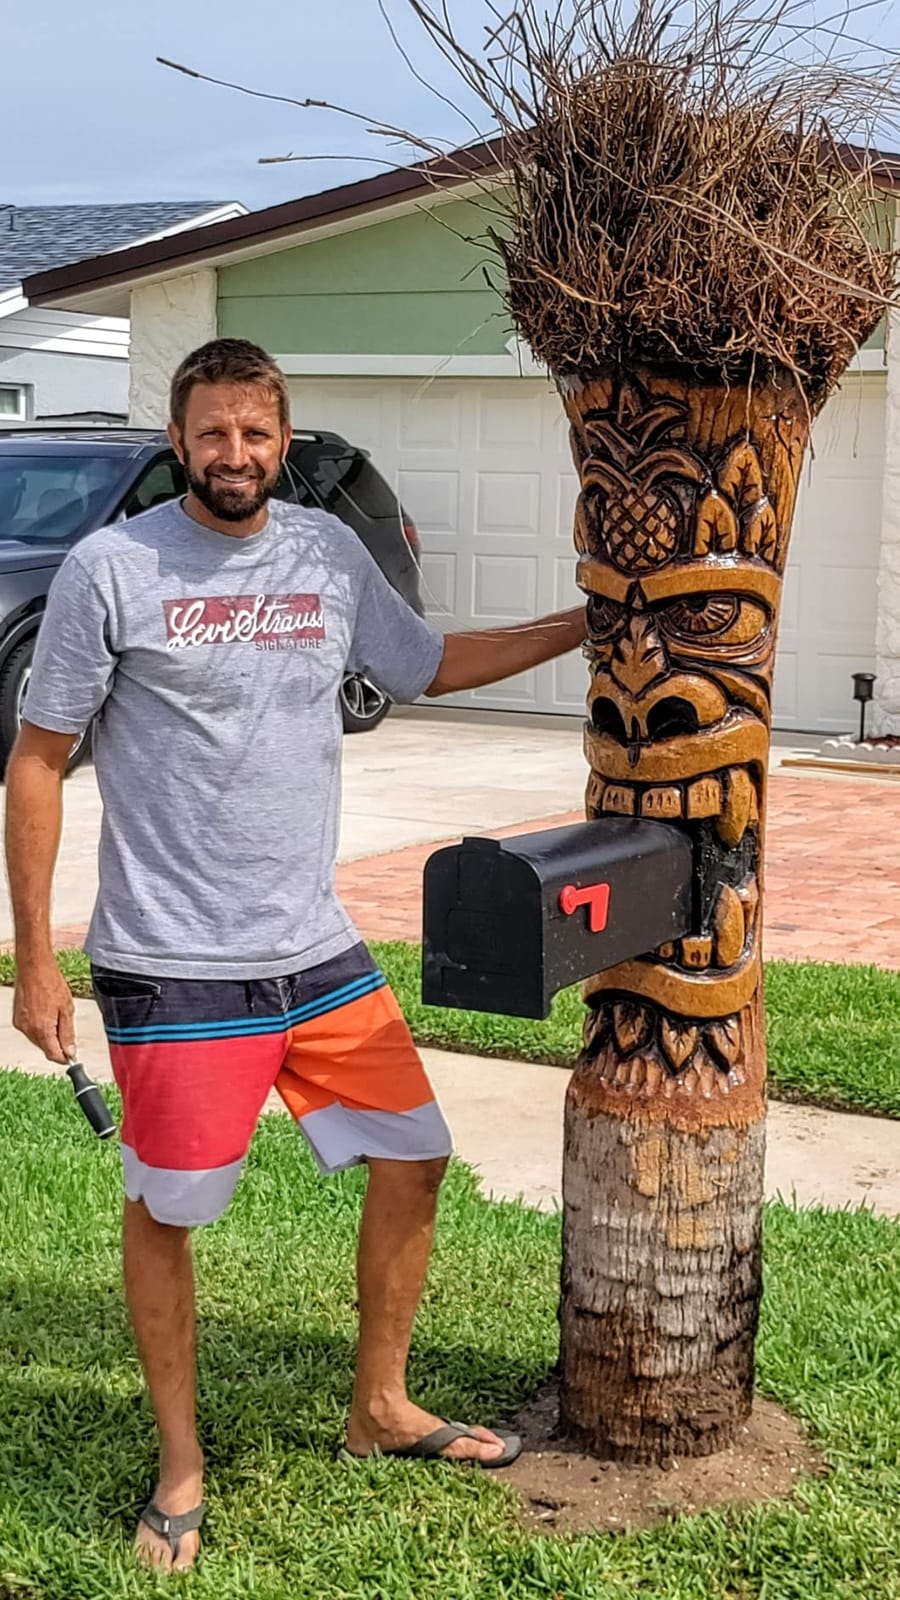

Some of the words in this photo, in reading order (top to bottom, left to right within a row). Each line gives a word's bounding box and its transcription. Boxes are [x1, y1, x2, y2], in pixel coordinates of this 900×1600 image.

[166, 600, 237, 652] Levi
[236, 594, 324, 641] Strauss
[255, 638, 321, 651] SIGNATURE
